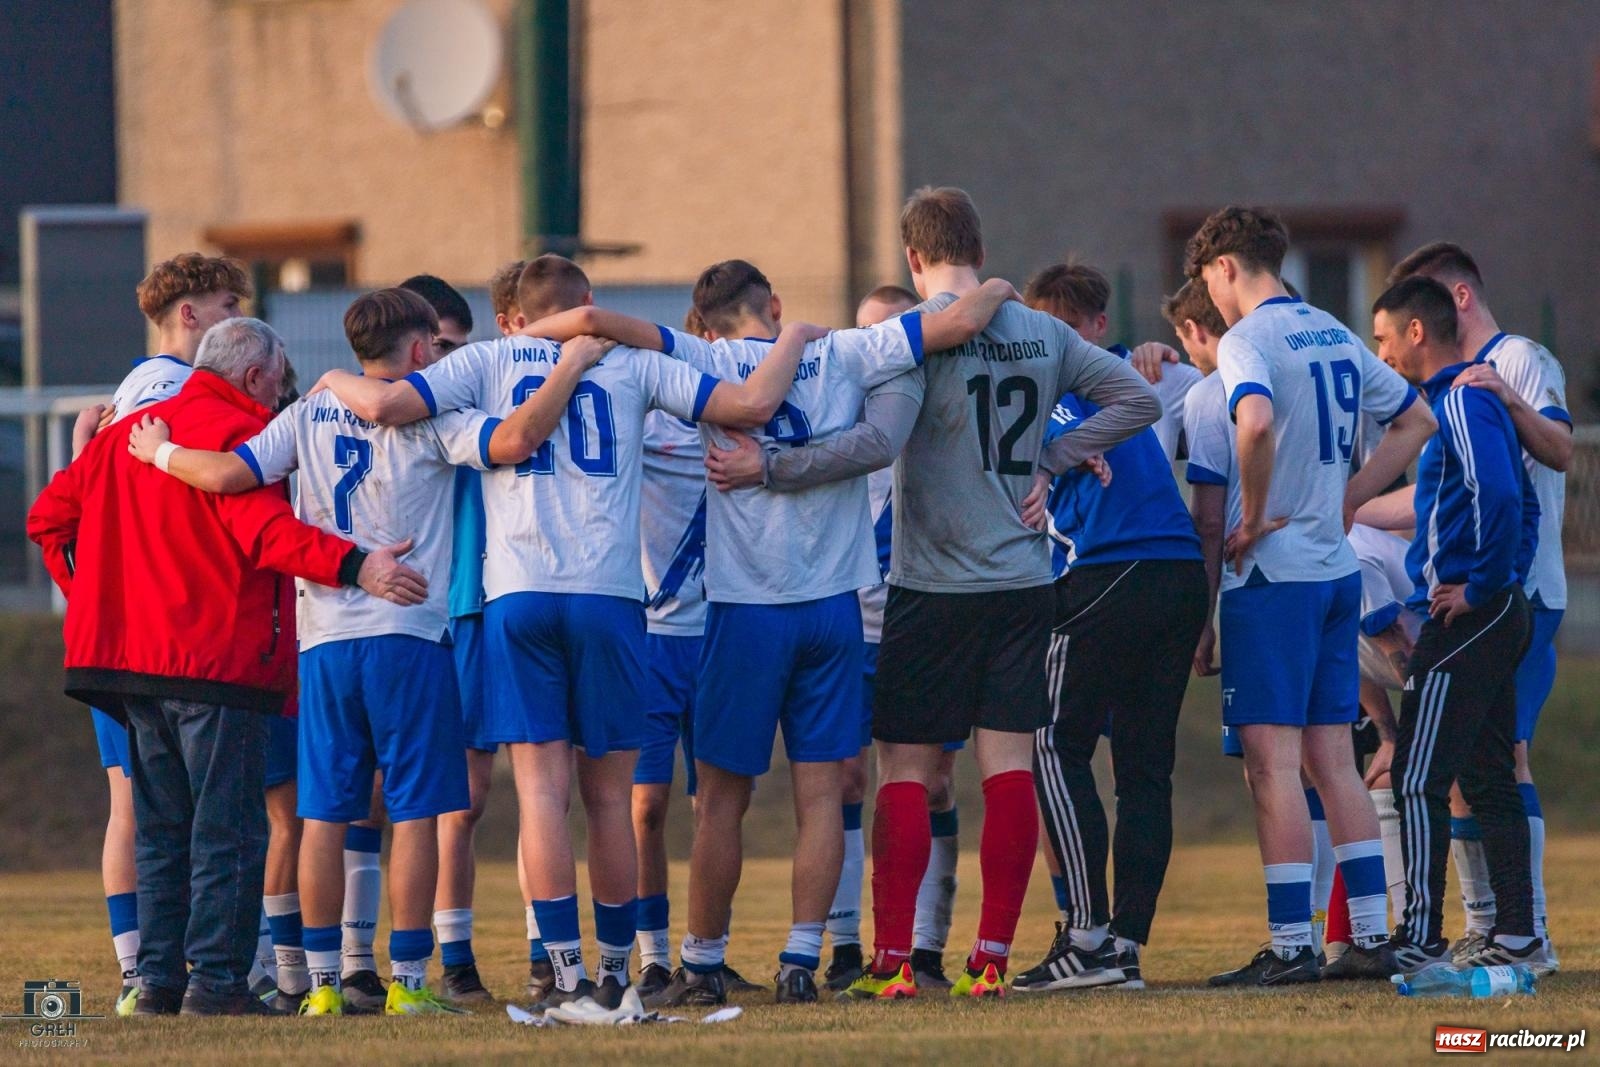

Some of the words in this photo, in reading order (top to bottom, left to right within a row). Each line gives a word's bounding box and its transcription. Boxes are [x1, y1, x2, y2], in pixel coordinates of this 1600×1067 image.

[512, 347, 548, 363] UNIA
[966, 374, 1039, 476] 12
[1309, 358, 1360, 464] 19
[334, 434, 374, 535] 7
[602, 956, 625, 972] FS
